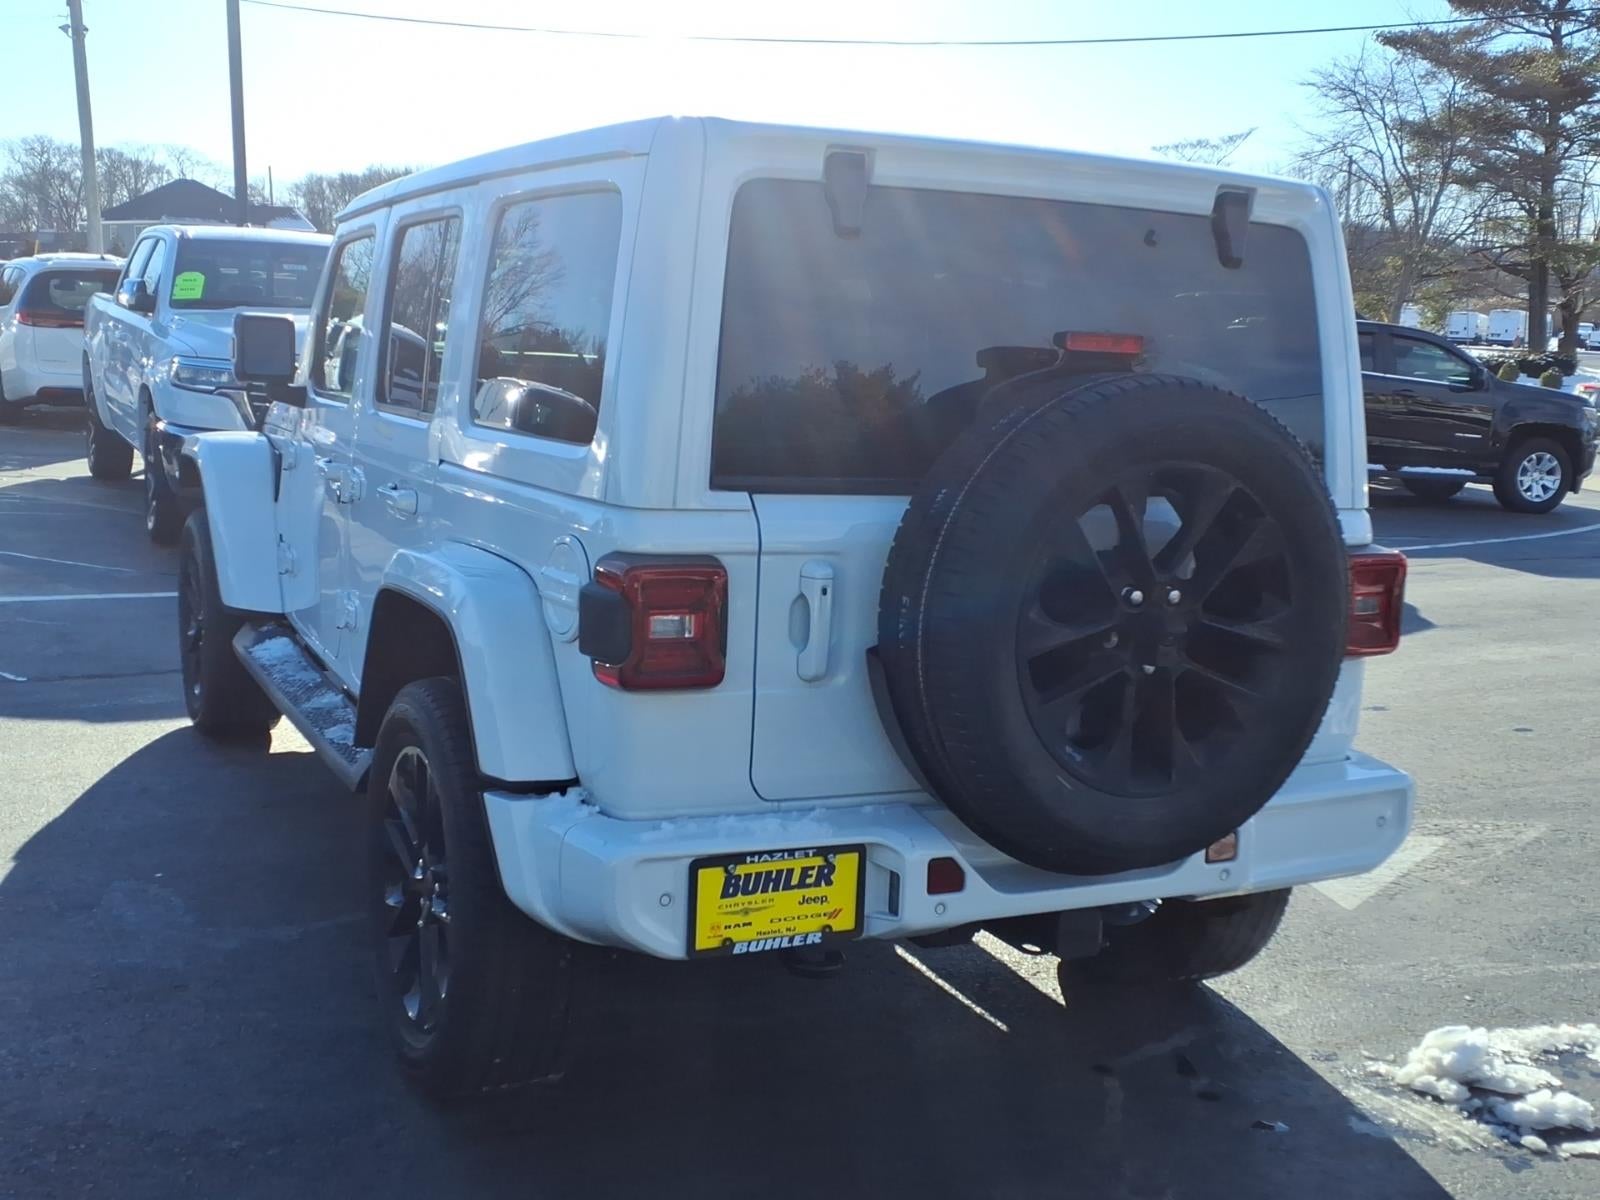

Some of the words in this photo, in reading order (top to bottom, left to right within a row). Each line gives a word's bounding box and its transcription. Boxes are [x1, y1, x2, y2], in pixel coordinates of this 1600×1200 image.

[746, 849, 817, 864] HAZLET
[720, 863, 836, 899] BUHLER
[718, 898, 775, 910] CHRYSLER
[798, 894, 828, 906] Jeep
[770, 910, 831, 924] DODGE
[724, 921, 753, 930] RAM
[732, 932, 822, 954] BUHLER
